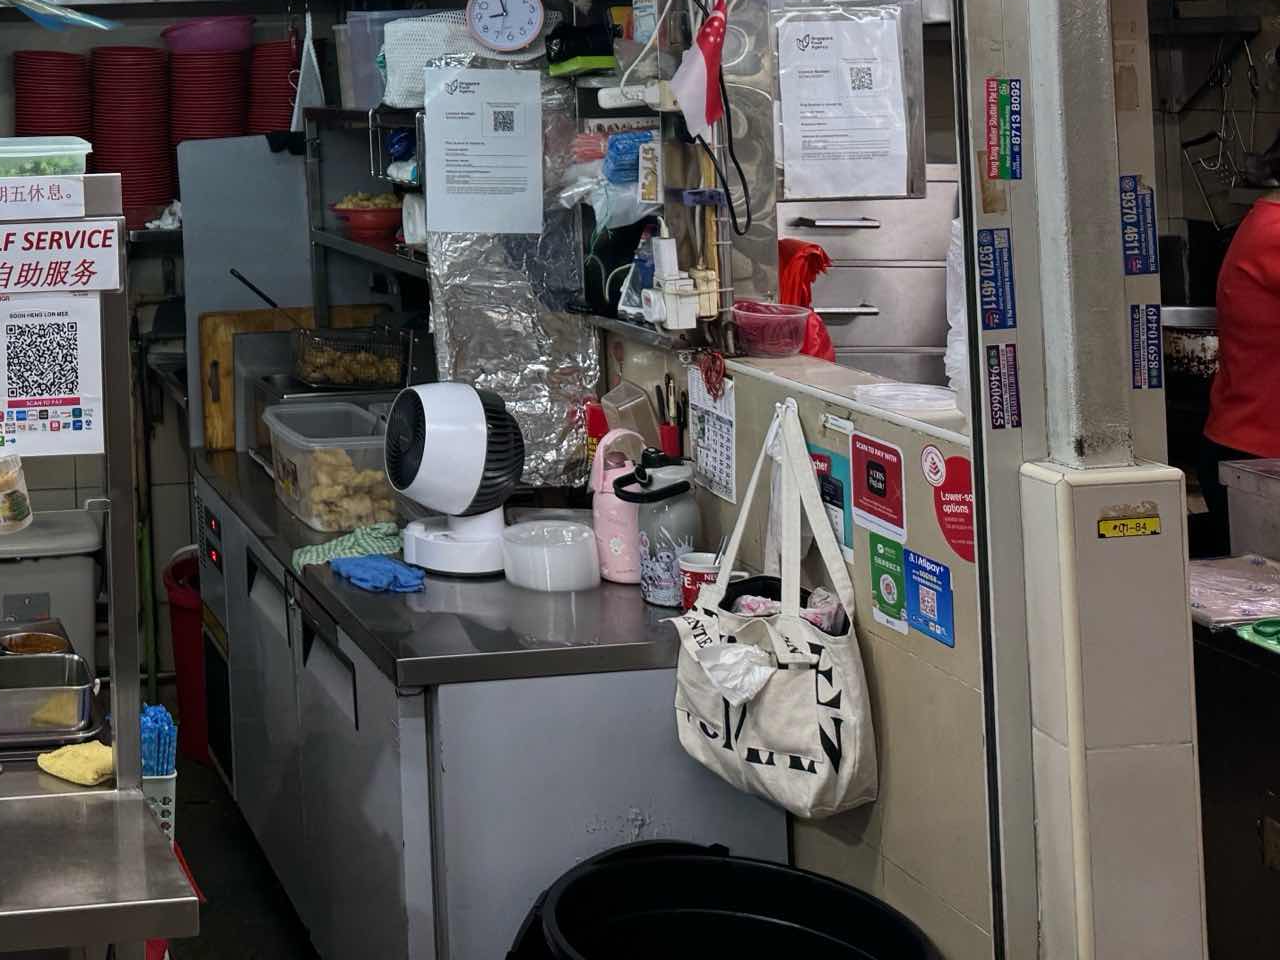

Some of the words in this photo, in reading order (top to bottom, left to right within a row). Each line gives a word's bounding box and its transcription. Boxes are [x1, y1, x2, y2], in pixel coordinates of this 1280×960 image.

[1011, 81, 1020, 111] 8092
[1011, 115, 1020, 144] 8713
[1121, 192, 1137, 223] 9370
[21, 229, 114, 250] SERVICE
[1124, 226, 1140, 254] 4611
[979, 246, 994, 276] 9370
[981, 280, 996, 309] 4611
[1147, 307, 1159, 368] 85910449
[989, 366, 1004, 426] 94606655
